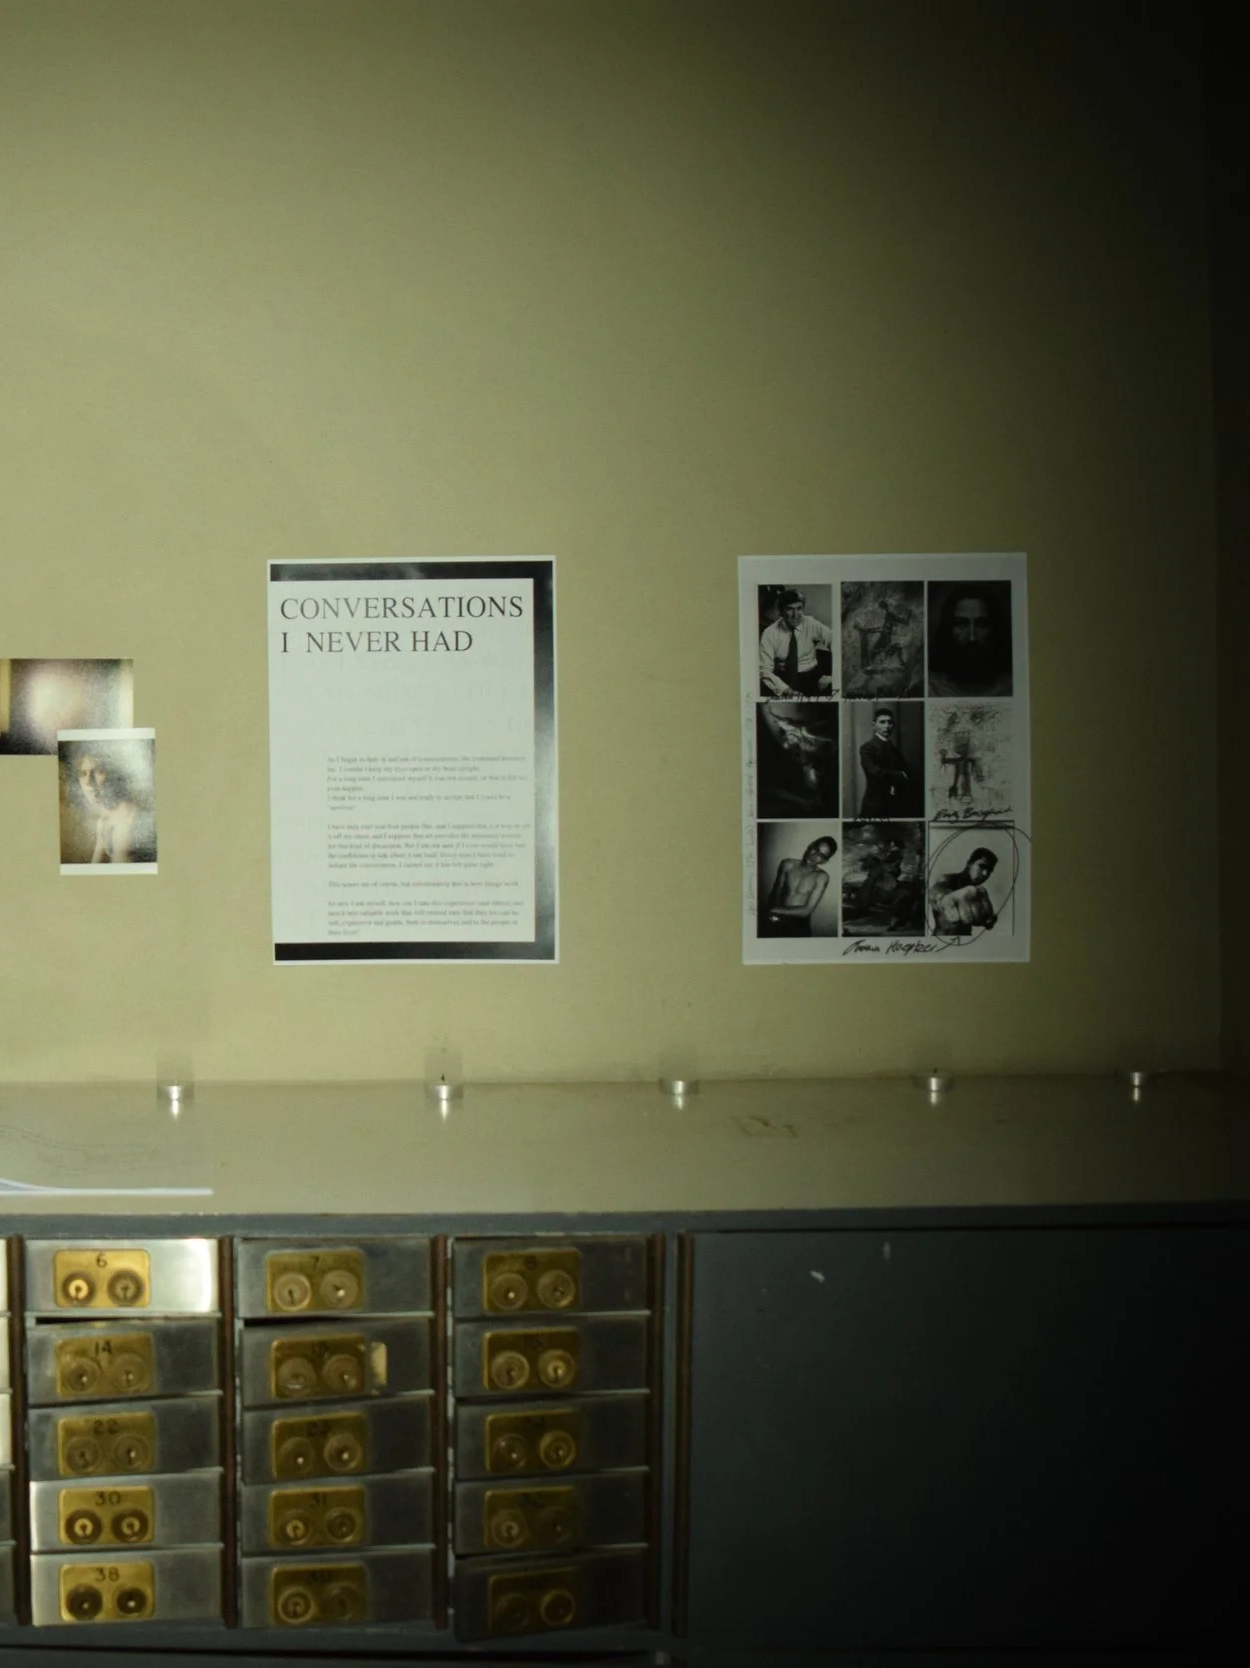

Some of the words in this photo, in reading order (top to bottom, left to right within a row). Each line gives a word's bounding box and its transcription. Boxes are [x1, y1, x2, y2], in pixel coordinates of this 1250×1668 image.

[280, 595, 524, 620] CONVERSATIONS
[281, 632, 289, 653] I
[306, 631, 401, 653] NEVER
[412, 630, 473, 652] HAD
[95, 1252, 108, 1269] 6
[309, 1255, 321, 1271] 7
[93, 1339, 113, 1356] 14
[92, 1418, 119, 1436] 22
[94, 1491, 122, 1507] 30
[94, 1566, 121, 1583] 38
